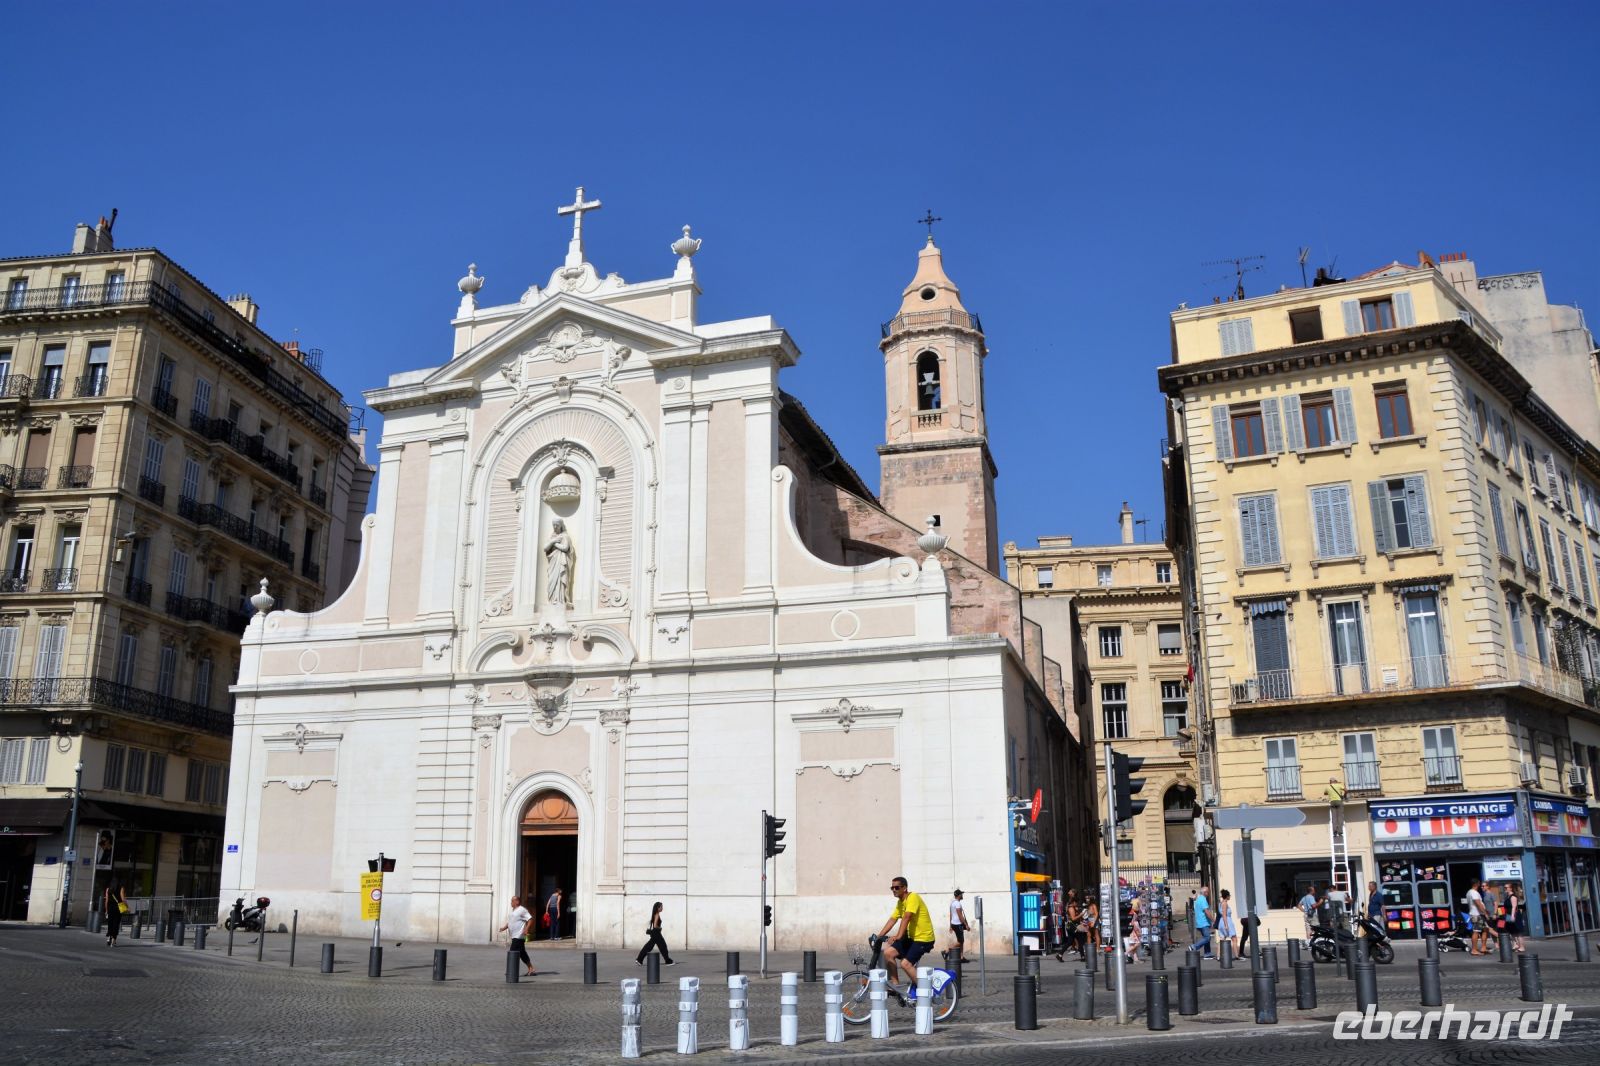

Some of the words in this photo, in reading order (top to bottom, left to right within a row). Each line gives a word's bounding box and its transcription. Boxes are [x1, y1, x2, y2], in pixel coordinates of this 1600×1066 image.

[1377, 806, 1433, 818] CAMBIO
[1449, 803, 1508, 815] CHANGE
[1382, 839, 1439, 852] CAMBIO
[1456, 836, 1514, 850] CHANGE
